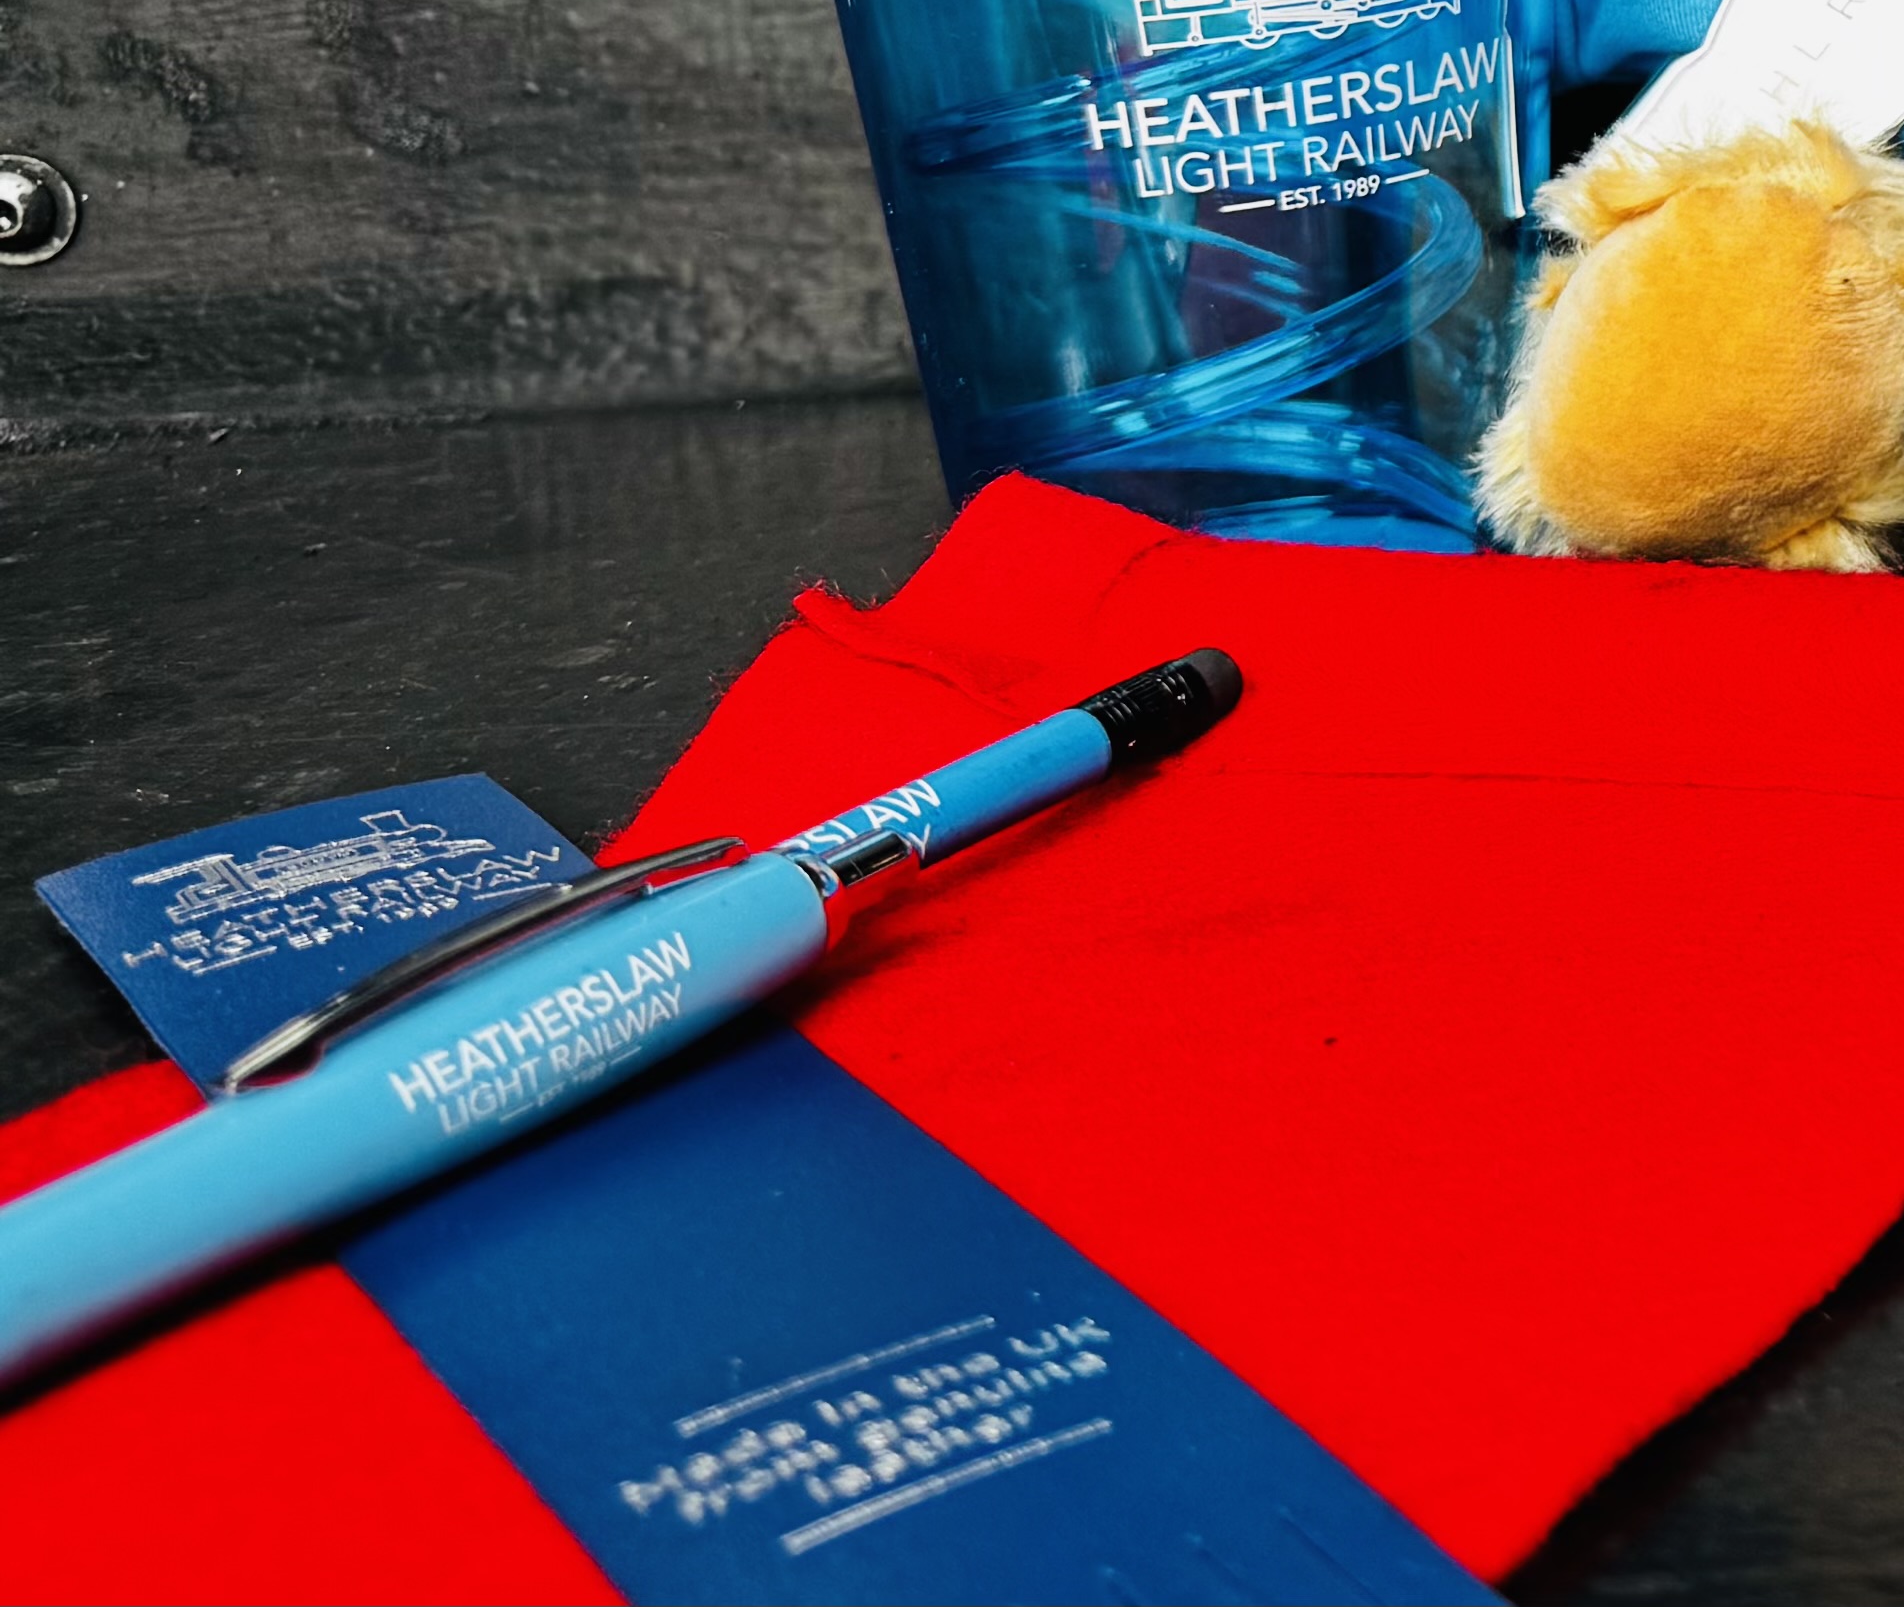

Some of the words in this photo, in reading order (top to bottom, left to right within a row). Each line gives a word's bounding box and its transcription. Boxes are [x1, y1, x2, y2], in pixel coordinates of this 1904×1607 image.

[1087, 37, 1500, 151] HEATHERSLAW
[1132, 141, 1286, 199] LIGHT
[1303, 100, 1480, 178] RAILWAY
[1279, 189, 1326, 212] EST.
[1332, 175, 1382, 204] 1989
[121, 845, 561, 969] HEATHERSLAW
[387, 930, 692, 1114] HEATHERSLAW
[437, 1055, 543, 1135] LIGHT
[550, 982, 683, 1075] RAILWAY
[617, 1420, 807, 1517] Made
[812, 1390, 881, 1428] in
[892, 1352, 1000, 1400] the
[1006, 1316, 1113, 1360] UK
[677, 1439, 842, 1525] from
[855, 1350, 1108, 1456] genuine
[803, 1404, 1033, 1507] leather
